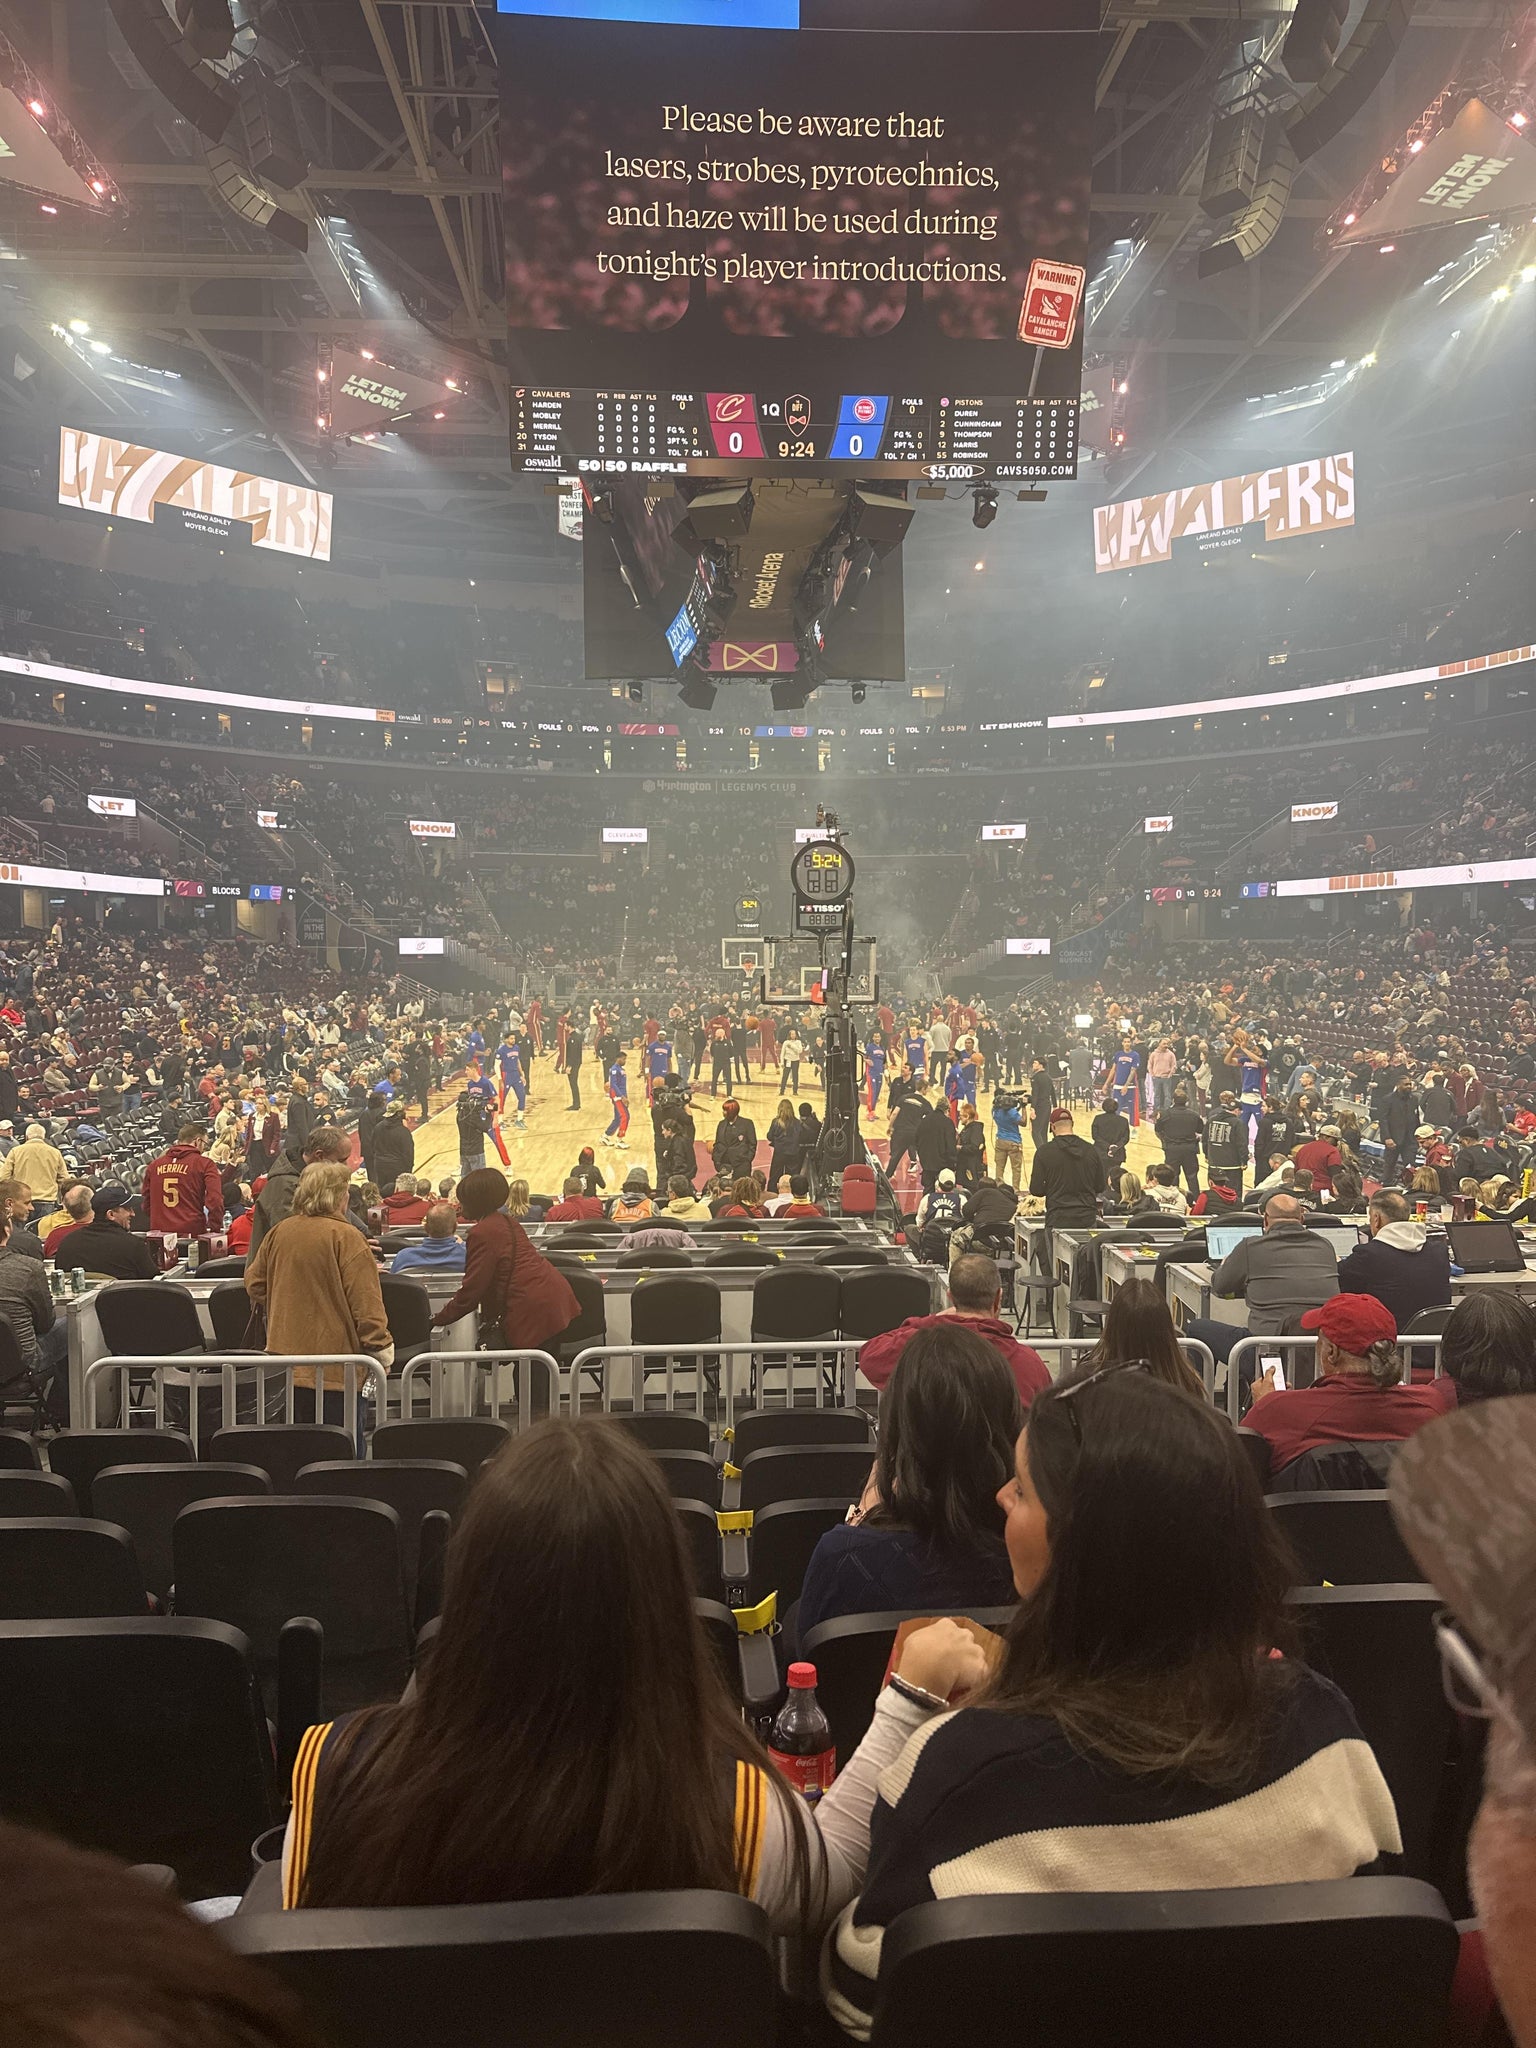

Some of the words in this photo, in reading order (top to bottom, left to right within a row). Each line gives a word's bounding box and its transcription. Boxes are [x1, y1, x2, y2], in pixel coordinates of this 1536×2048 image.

[663, 105, 752, 133] Please
[758, 108, 792, 134] be
[798, 116, 880, 137] aware
[886, 112, 944, 138] that
[605, 150, 691, 184] lasers,
[698, 157, 805, 188] strobes,
[811, 157, 999, 191] pyrotechnics,
[1446, 154, 1484, 179] EM
[1441, 157, 1515, 209] KNOW.
[608, 202, 660, 226] and
[666, 202, 732, 229] haze
[739, 206, 787, 231] will
[793, 207, 826, 232] be
[833, 209, 899, 233] used
[905, 209, 997, 240] during
[723, 253, 807, 284] player
[812, 255, 1006, 281] introductions.
[1037, 269, 1076, 286] WARNING
[1033, 326, 1057, 338] DANGER
[347, 375, 382, 391] LET
[380, 385, 408, 400] EM
[340, 384, 400, 410] KNOW.
[531, 390, 571, 399] CAVALIERS
[518, 400, 523, 408] 1
[532, 401, 562, 409] HARDEN
[597, 402, 604, 411] 0
[615, 403, 622, 412] 0
[631, 403, 639, 412] 0
[648, 404, 655, 413] 0
[679, 401, 686, 411] 0
[901, 398, 924, 406] FOULS
[518, 410, 525, 419] 4
[532, 412, 562, 420] MOBLEY
[762, 404, 779, 416] 1Q
[909, 405, 916, 415] 0
[939, 409, 946, 418] 0
[518, 421, 525, 430] 5
[532, 422, 562, 431] MERRILL
[939, 420, 946, 428] 2
[953, 420, 1002, 428] CUNNINGHAM
[666, 426, 678, 434] FG
[677, 426, 686, 434] %
[692, 426, 698, 435] 0
[893, 430, 905, 439] FG
[904, 431, 913, 439] %
[917, 431, 923, 439] 0
[939, 430, 946, 438] 9
[953, 430, 993, 438] THOMPSON
[516, 432, 528, 440] 20
[532, 433, 558, 441] TYSON
[666, 437, 681, 445] 3PT
[680, 437, 689, 445] %
[692, 438, 698, 446] 0
[517, 442, 527, 451] 31
[533, 444, 556, 452] ALLEN
[728, 431, 743, 454] 0
[850, 435, 862, 455] 0
[893, 441, 907, 449] 3PT
[907, 441, 915, 449] %
[917, 441, 923, 450] 0
[937, 441, 947, 449] 12
[952, 441, 979, 449] HARRIS
[667, 448, 682, 457] TOL
[683, 448, 689, 457] 7
[691, 449, 703, 457] CH
[779, 442, 814, 457] 9:24
[883, 452, 898, 460] TOL
[899, 452, 905, 460] 7
[906, 452, 918, 460] CH
[936, 451, 948, 459] 55
[952, 451, 989, 459] ROBINSON
[524, 455, 561, 469] oswald
[632, 462, 687, 472] RAFFLE
[930, 465, 973, 478] $5,000
[997, 466, 1073, 475] CAVS5050.COM
[209, 516, 232, 526] ASHLEY
[1222, 527, 1243, 536] ASHLEY
[755, 553, 784, 579] Arena
[501, 721, 517, 729] TOL
[522, 721, 528, 730] 7
[537, 723, 562, 731] FOULS
[606, 725, 612, 733] 0
[1013, 720, 1043, 728] KNOW.
[658, 725, 665, 735] 0
[708, 727, 724, 735] 9:24
[767, 727, 774, 736] 0
[859, 727, 883, 735] FOULS
[904, 726, 920, 734] TOL
[100, 801, 124, 811] LET
[410, 823, 454, 834] KNOW.
[1150, 820, 1167, 828] EM
[992, 826, 1015, 837] LET
[812, 854, 842, 868] 9:24
[196, 885, 203, 895] 0
[212, 886, 241, 896] BLOCKS
[254, 887, 261, 897] 0
[1176, 890, 1182, 899] 0
[1204, 889, 1221, 897] 9:24
[1243, 887, 1249, 895] 0
[157, 1163, 188, 1175] MERRILL
[163, 1178, 179, 1207] 5
